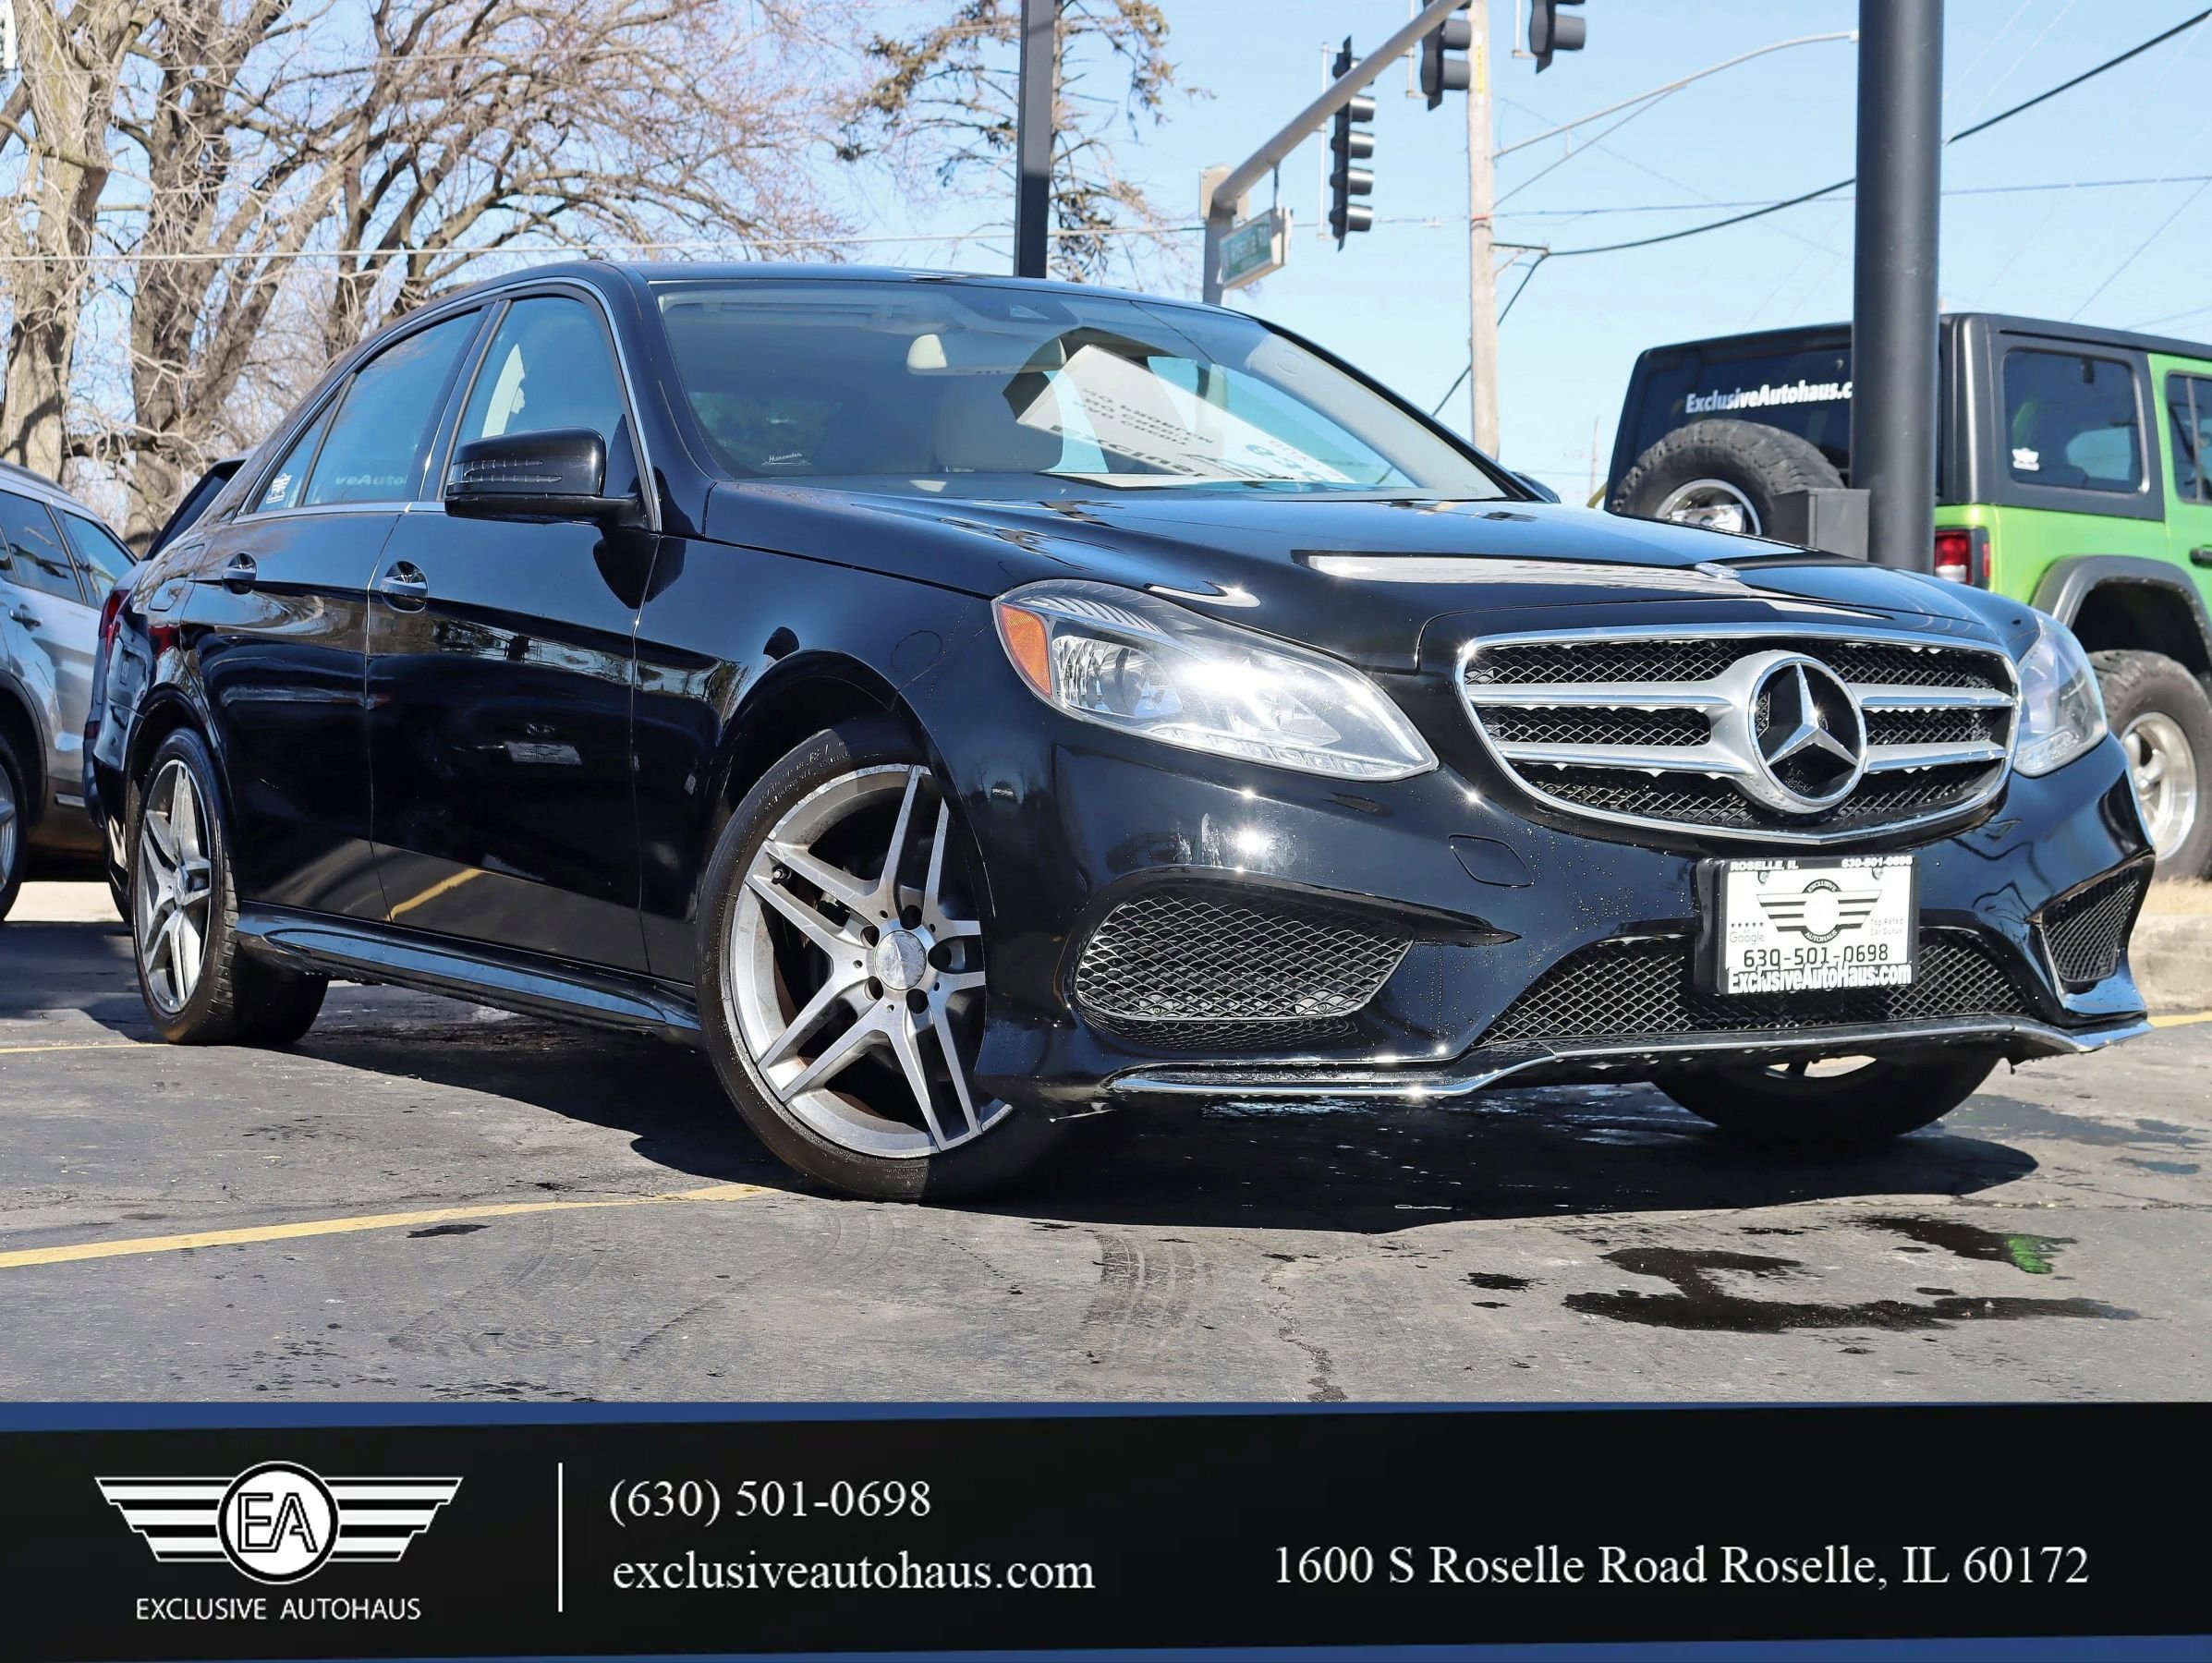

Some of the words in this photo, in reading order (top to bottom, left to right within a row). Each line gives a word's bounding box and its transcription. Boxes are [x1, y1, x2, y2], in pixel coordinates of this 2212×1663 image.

[334, 473, 407, 486] veAuto
[1787, 859, 1799, 870] IL
[1729, 930, 1765, 945] Google
[1805, 929, 1839, 943] AUTOHAUS
[1744, 943, 1889, 968] 630-501-0698
